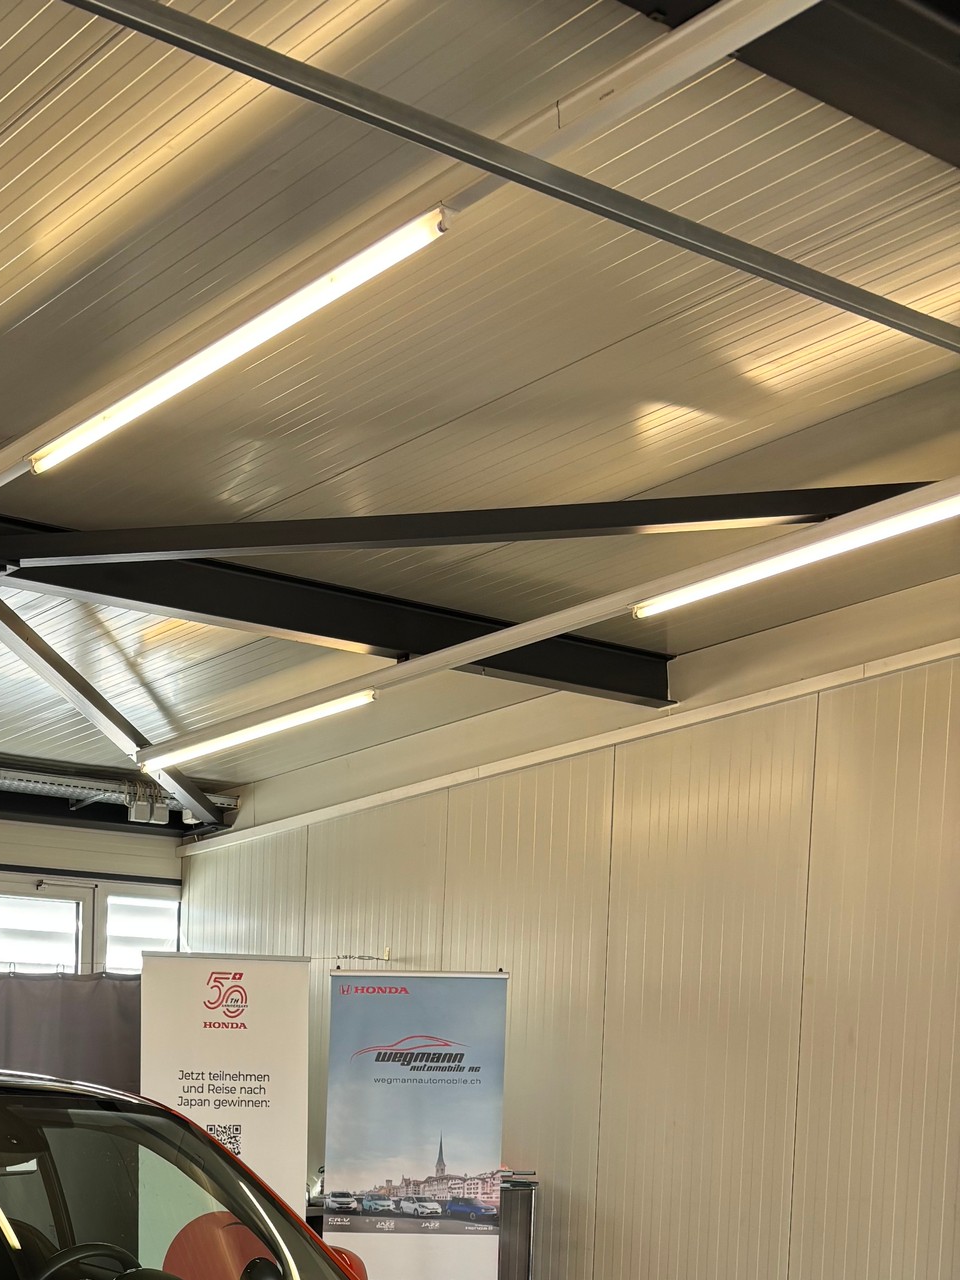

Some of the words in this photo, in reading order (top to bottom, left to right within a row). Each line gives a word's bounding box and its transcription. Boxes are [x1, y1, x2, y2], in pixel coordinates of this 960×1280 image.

[353, 986, 410, 995] HONDA
[203, 1021, 248, 1029] HONDA
[374, 1051, 465, 1067] wegmann
[178, 1070, 205, 1081] Jetzt
[208, 1071, 270, 1082] teilnehmen
[373, 1077, 482, 1085] wegmannautomobile.ch
[182, 1084, 204, 1094] und
[208, 1084, 237, 1094] Reise
[240, 1085, 266, 1095] nach
[177, 1096, 211, 1109] Japan
[213, 1098, 270, 1109] gewinnen:
